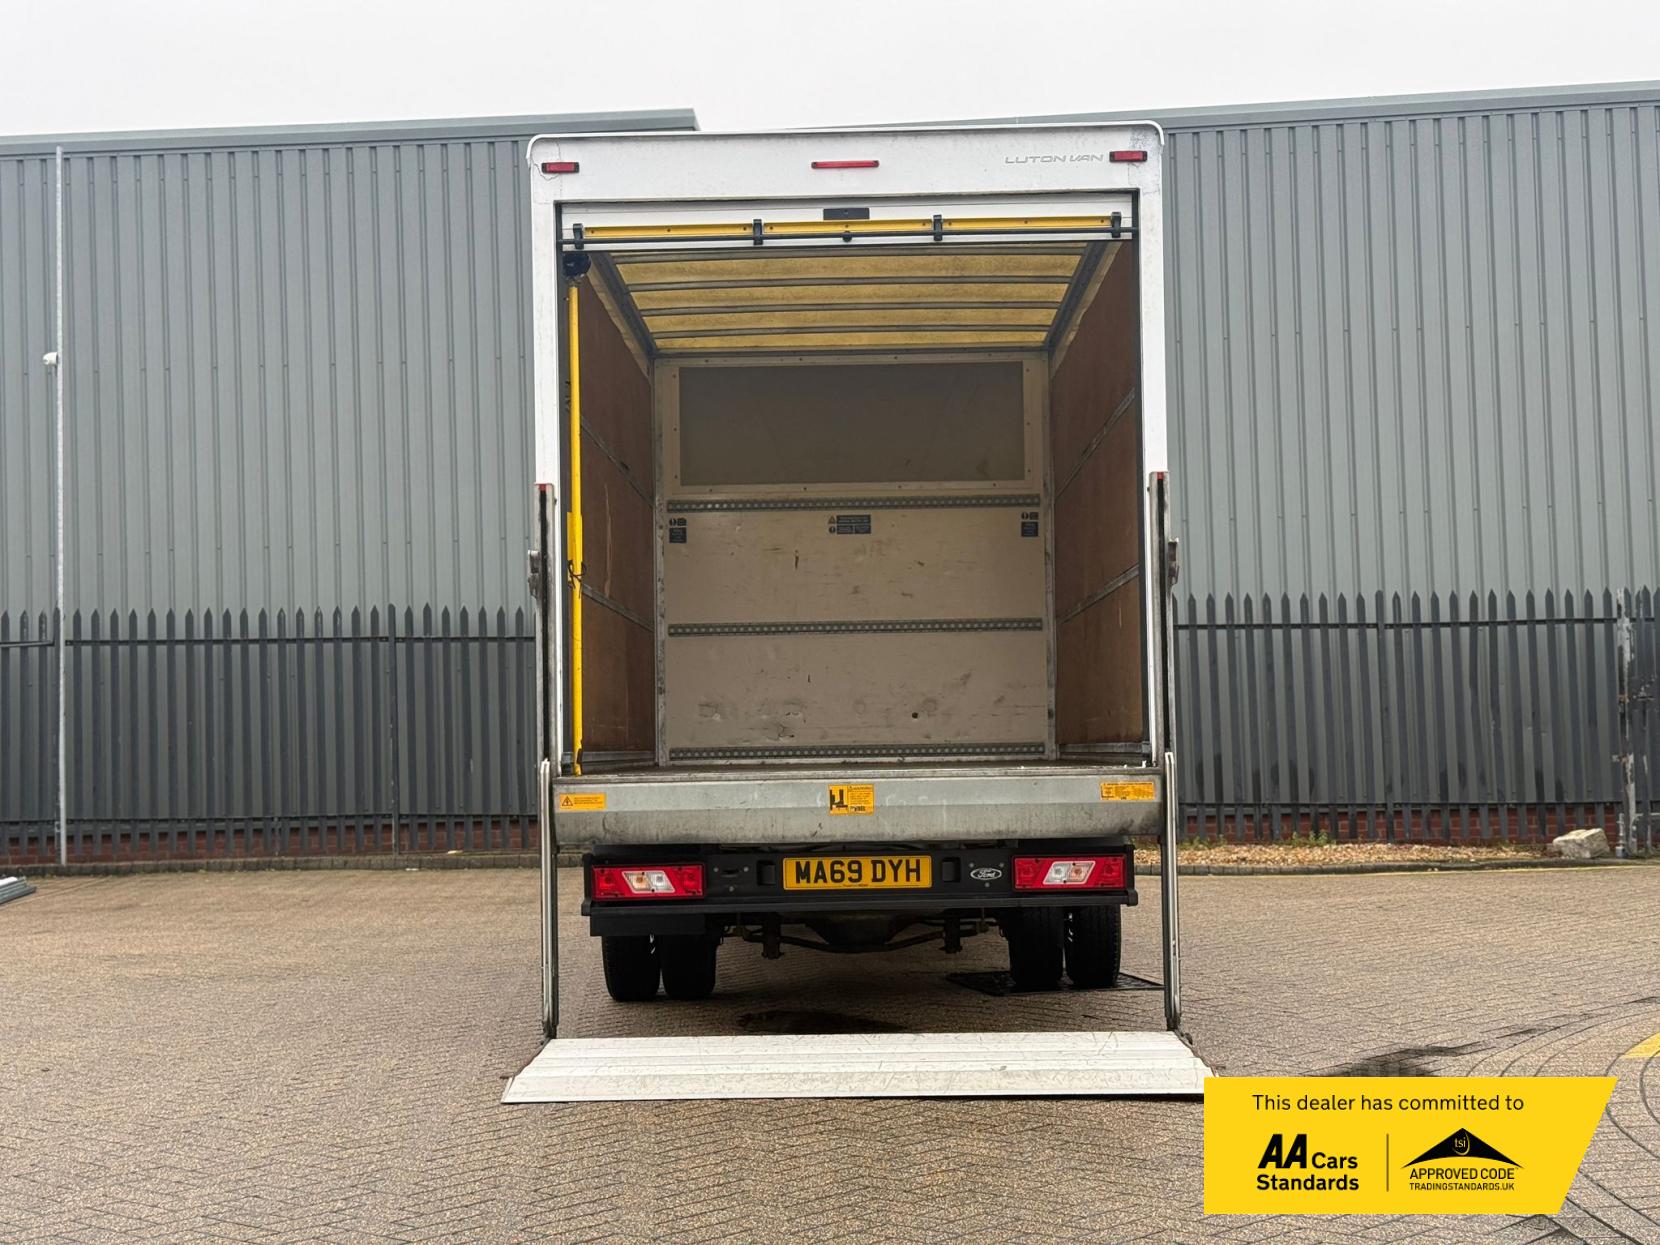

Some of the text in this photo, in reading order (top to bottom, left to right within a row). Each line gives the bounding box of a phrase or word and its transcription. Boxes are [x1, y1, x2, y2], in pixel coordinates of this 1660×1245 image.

[1005, 154, 1104, 164] LUTON VAN
[795, 859, 921, 884] MA69 DYH
